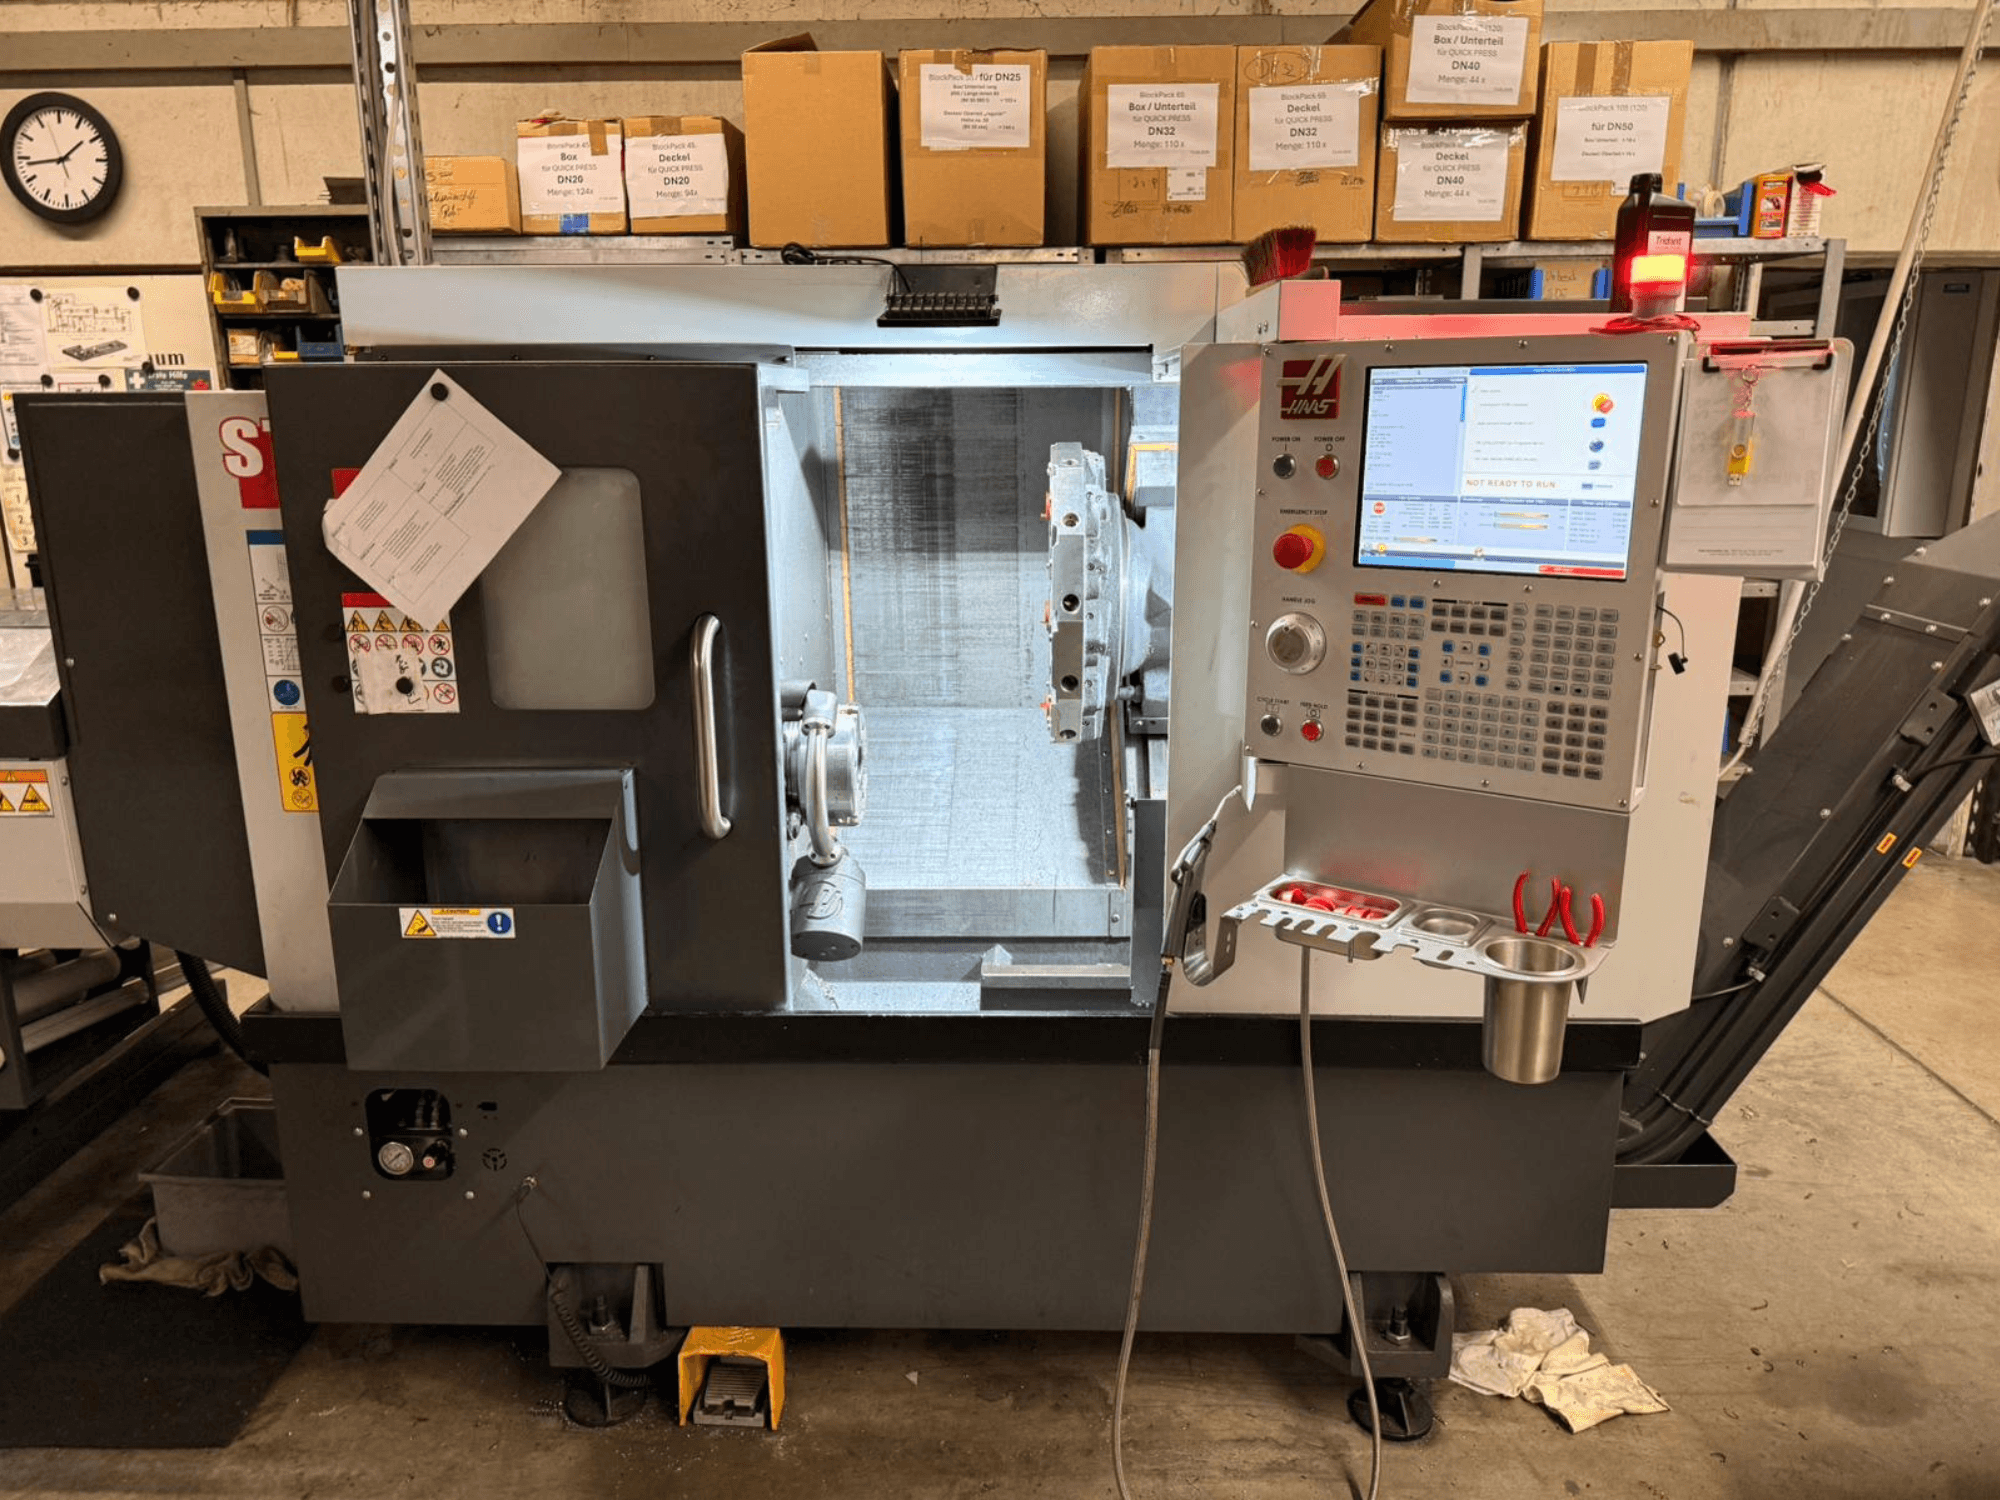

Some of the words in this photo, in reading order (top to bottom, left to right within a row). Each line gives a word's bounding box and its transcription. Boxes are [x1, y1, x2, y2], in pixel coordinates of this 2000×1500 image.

[1433, 35, 1452, 44] Box
[1460, 35, 1504, 46] Unterteil
[1448, 49, 1472, 57] QUICK
[1474, 49, 1498, 57] PRESS
[1452, 61, 1481, 70] DN40
[979, 73, 993, 81] für
[995, 73, 1021, 82] DN25
[1438, 75, 1467, 85] Menge:
[1281, 93, 1316, 101] BlockPack
[1128, 102, 1146, 111] Box
[1154, 102, 1196, 111] Unterteil
[1287, 103, 1321, 113] Deckel
[1144, 115, 1167, 123] QUICK
[1168, 114, 1191, 122] PRESS
[1286, 117, 1309, 125] QUICK
[1310, 115, 1333, 123] PRESS
[1148, 126, 1176, 136] DN32
[1591, 122, 1605, 131] für
[1607, 122, 1634, 131] DN50
[1289, 128, 1318, 137] DN32
[1133, 140, 1162, 150] Menge:
[1165, 140, 1180, 148] 110
[1275, 142, 1304, 151] Menge:
[1306, 141, 1321, 149] 110
[560, 152, 578, 161] Box
[658, 153, 691, 163] Deckel
[1435, 151, 1469, 161] Deckel
[552, 164, 575, 172] QUICK
[576, 163, 598, 171] PRESS
[658, 165, 681, 174] QUICK
[681, 164, 704, 172] PRESS
[1433, 164, 1456, 172] QUICK
[1458, 164, 1481, 172] PRESS
[557, 174, 584, 185] DN20
[663, 176, 691, 186] DN20
[1436, 175, 1465, 185] DN40
[547, 188, 575, 198] Menge:
[656, 190, 683, 199] Menge:
[1424, 189, 1453, 199] Menge:
[1454, 189, 1465, 197] 44
[168, 370, 189, 380] Hilfe
[1465, 478, 1484, 487] NOT
[1487, 479, 1518, 488] READY
[1521, 480, 1534, 489] TO
[1535, 480, 1556, 490] RUN
